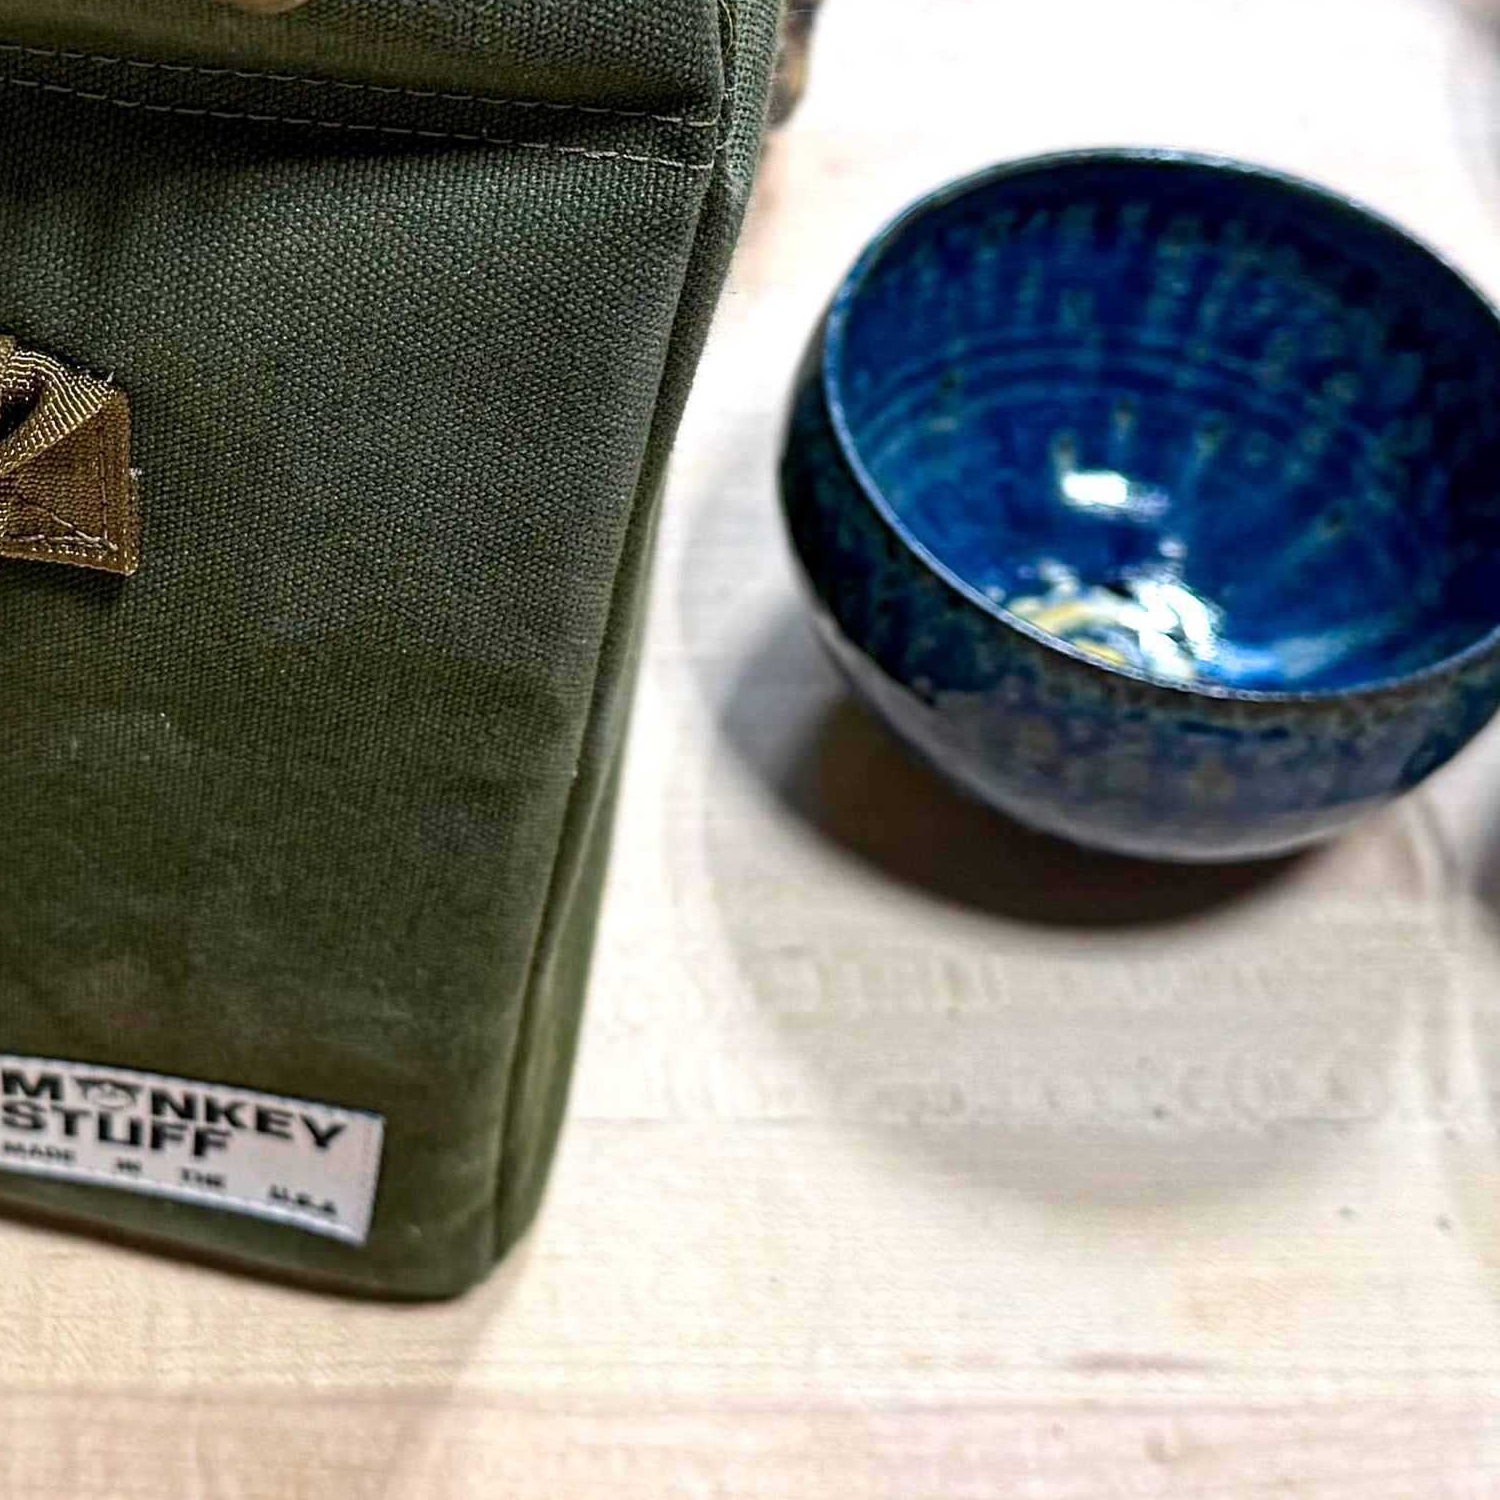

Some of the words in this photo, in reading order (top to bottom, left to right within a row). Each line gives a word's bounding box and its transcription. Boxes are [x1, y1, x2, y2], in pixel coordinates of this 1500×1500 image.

[1, 1100, 233, 1158] STUFF
[2, 1141, 76, 1164] MADE
[115, 1157, 142, 1176] IN
[180, 1167, 227, 1190] THE
